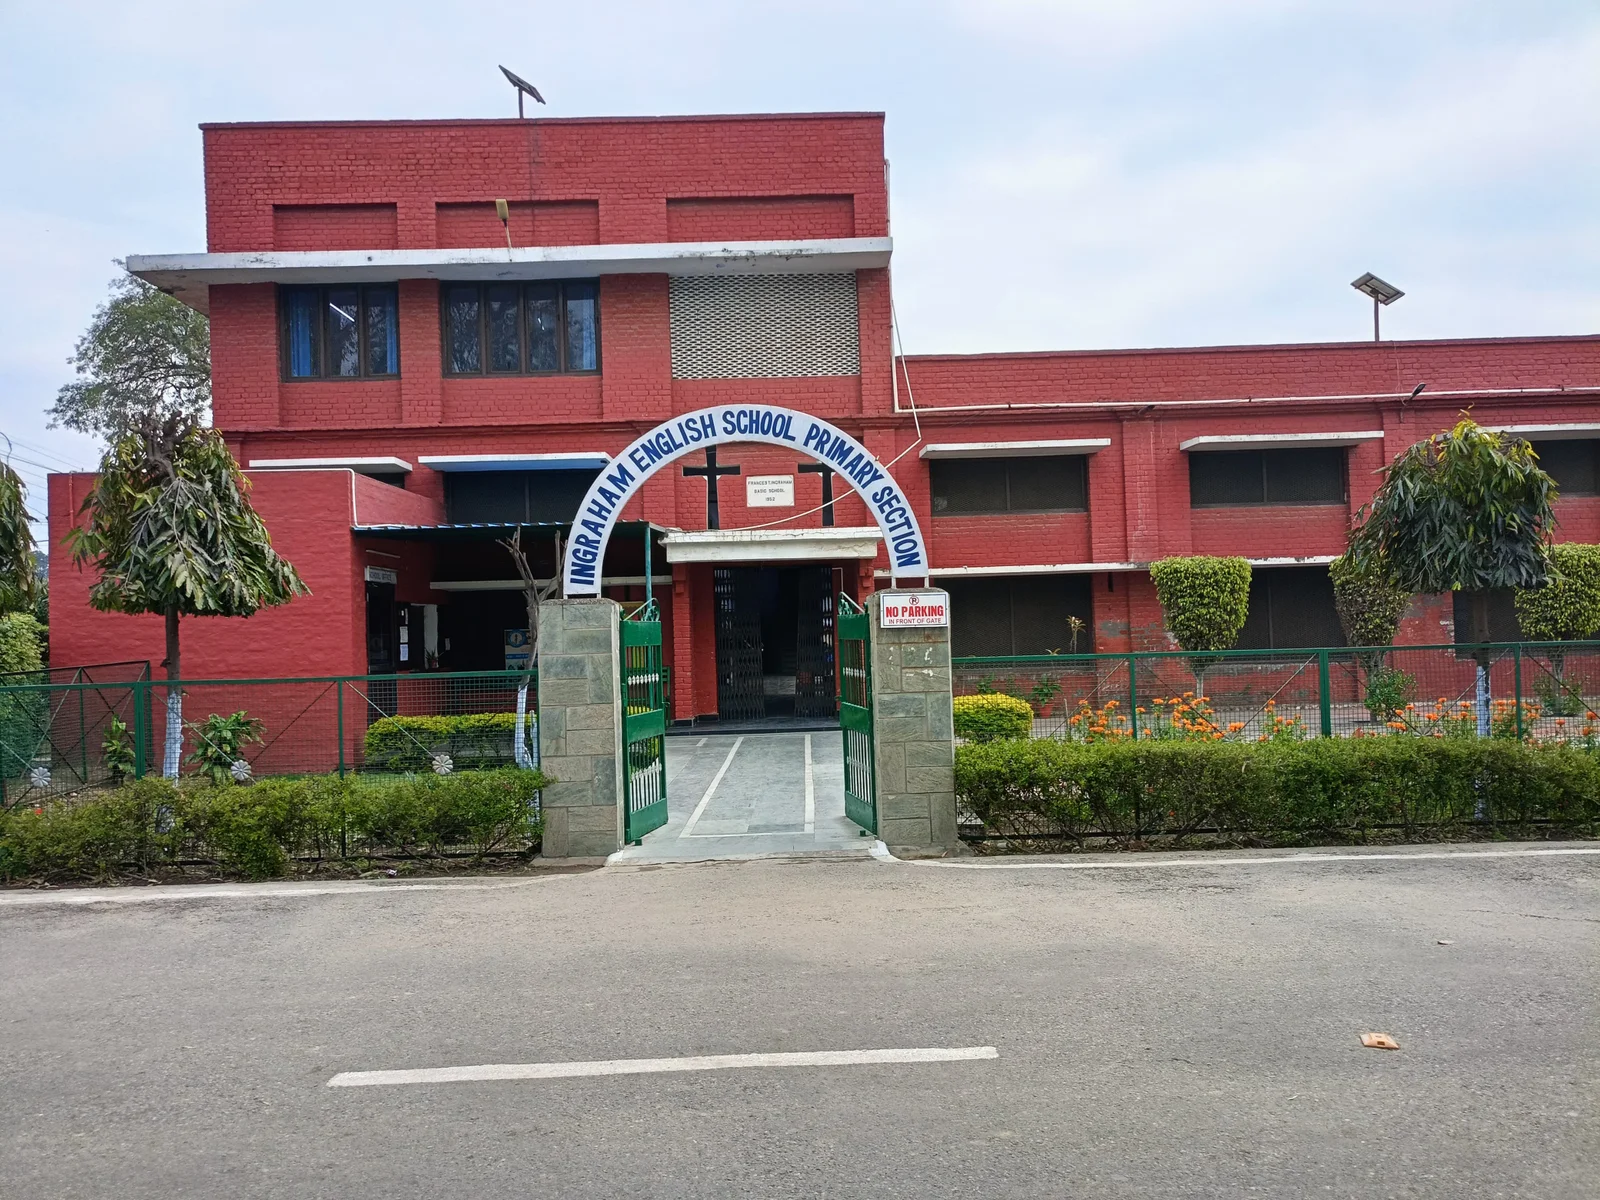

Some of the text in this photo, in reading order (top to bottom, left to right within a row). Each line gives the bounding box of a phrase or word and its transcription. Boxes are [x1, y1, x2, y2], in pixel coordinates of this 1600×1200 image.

[570, 409, 922, 586] INGRAHAM ENGLISH SCHOOL PRIMARY SECTION
[885, 605, 944, 618] NO PARKING
